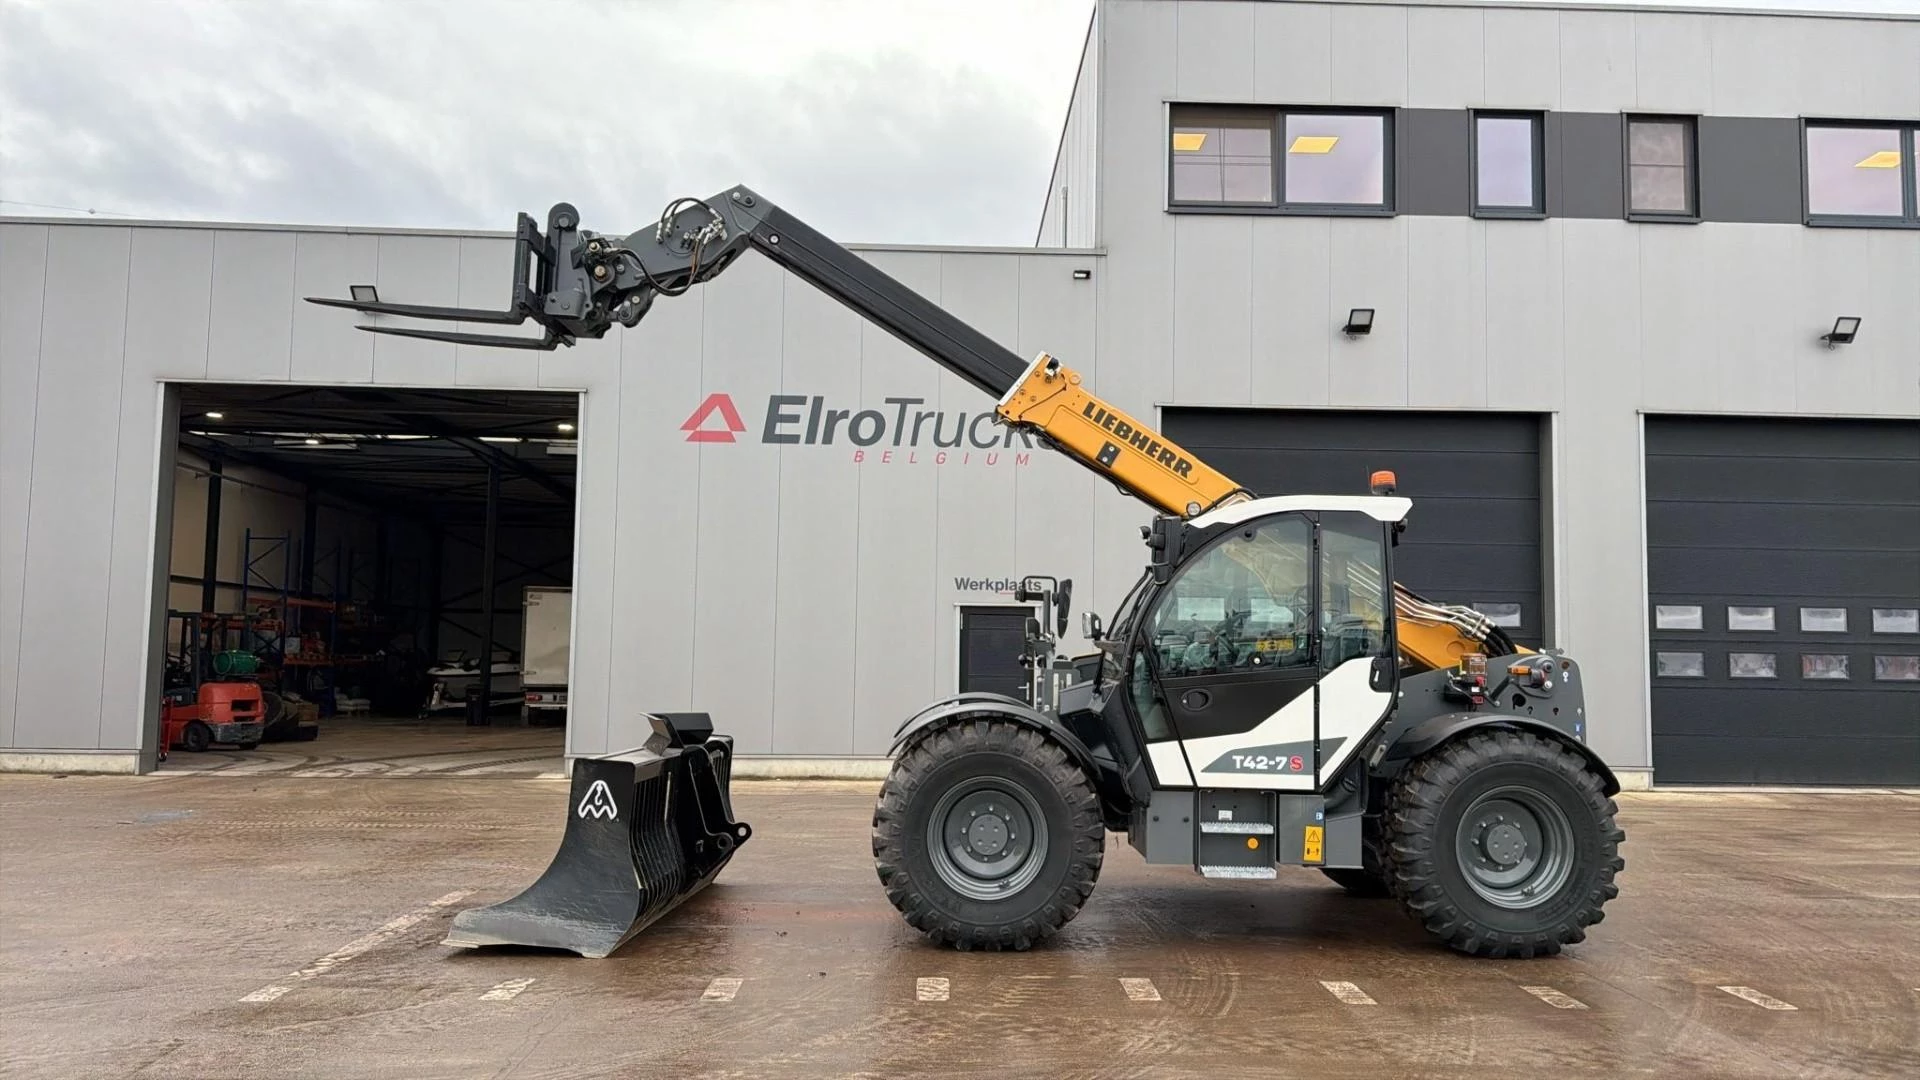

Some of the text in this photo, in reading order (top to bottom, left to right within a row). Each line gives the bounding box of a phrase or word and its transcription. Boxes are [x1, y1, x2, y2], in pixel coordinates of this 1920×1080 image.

[762, 394, 1055, 450] ElroTruc
[1082, 401, 1193, 479] LIEBHERR
[853, 450, 1030, 466] BELGIUM
